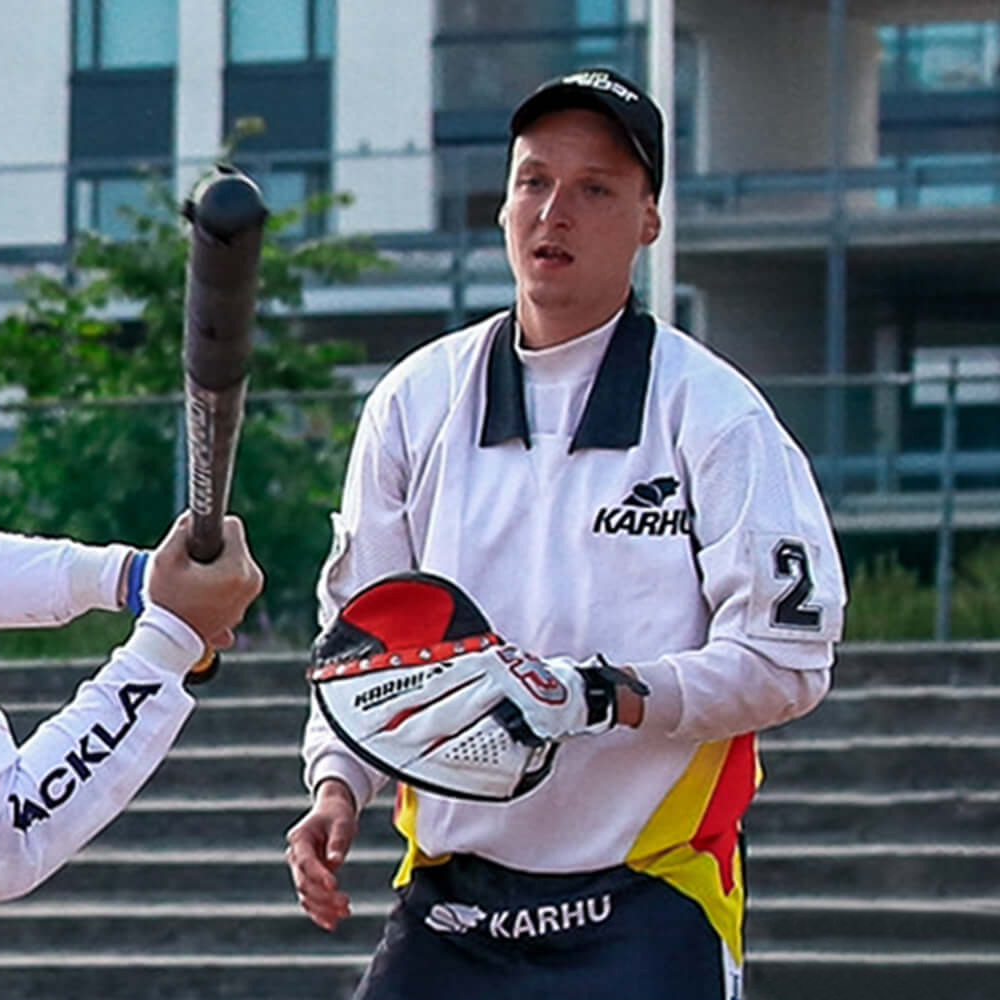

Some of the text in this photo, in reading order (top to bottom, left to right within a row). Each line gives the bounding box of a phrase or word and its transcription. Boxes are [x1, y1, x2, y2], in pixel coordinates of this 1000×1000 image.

[769, 538, 824, 632] 2
[7, 683, 163, 832] ACKLA
[489, 893, 612, 939] KARHU
